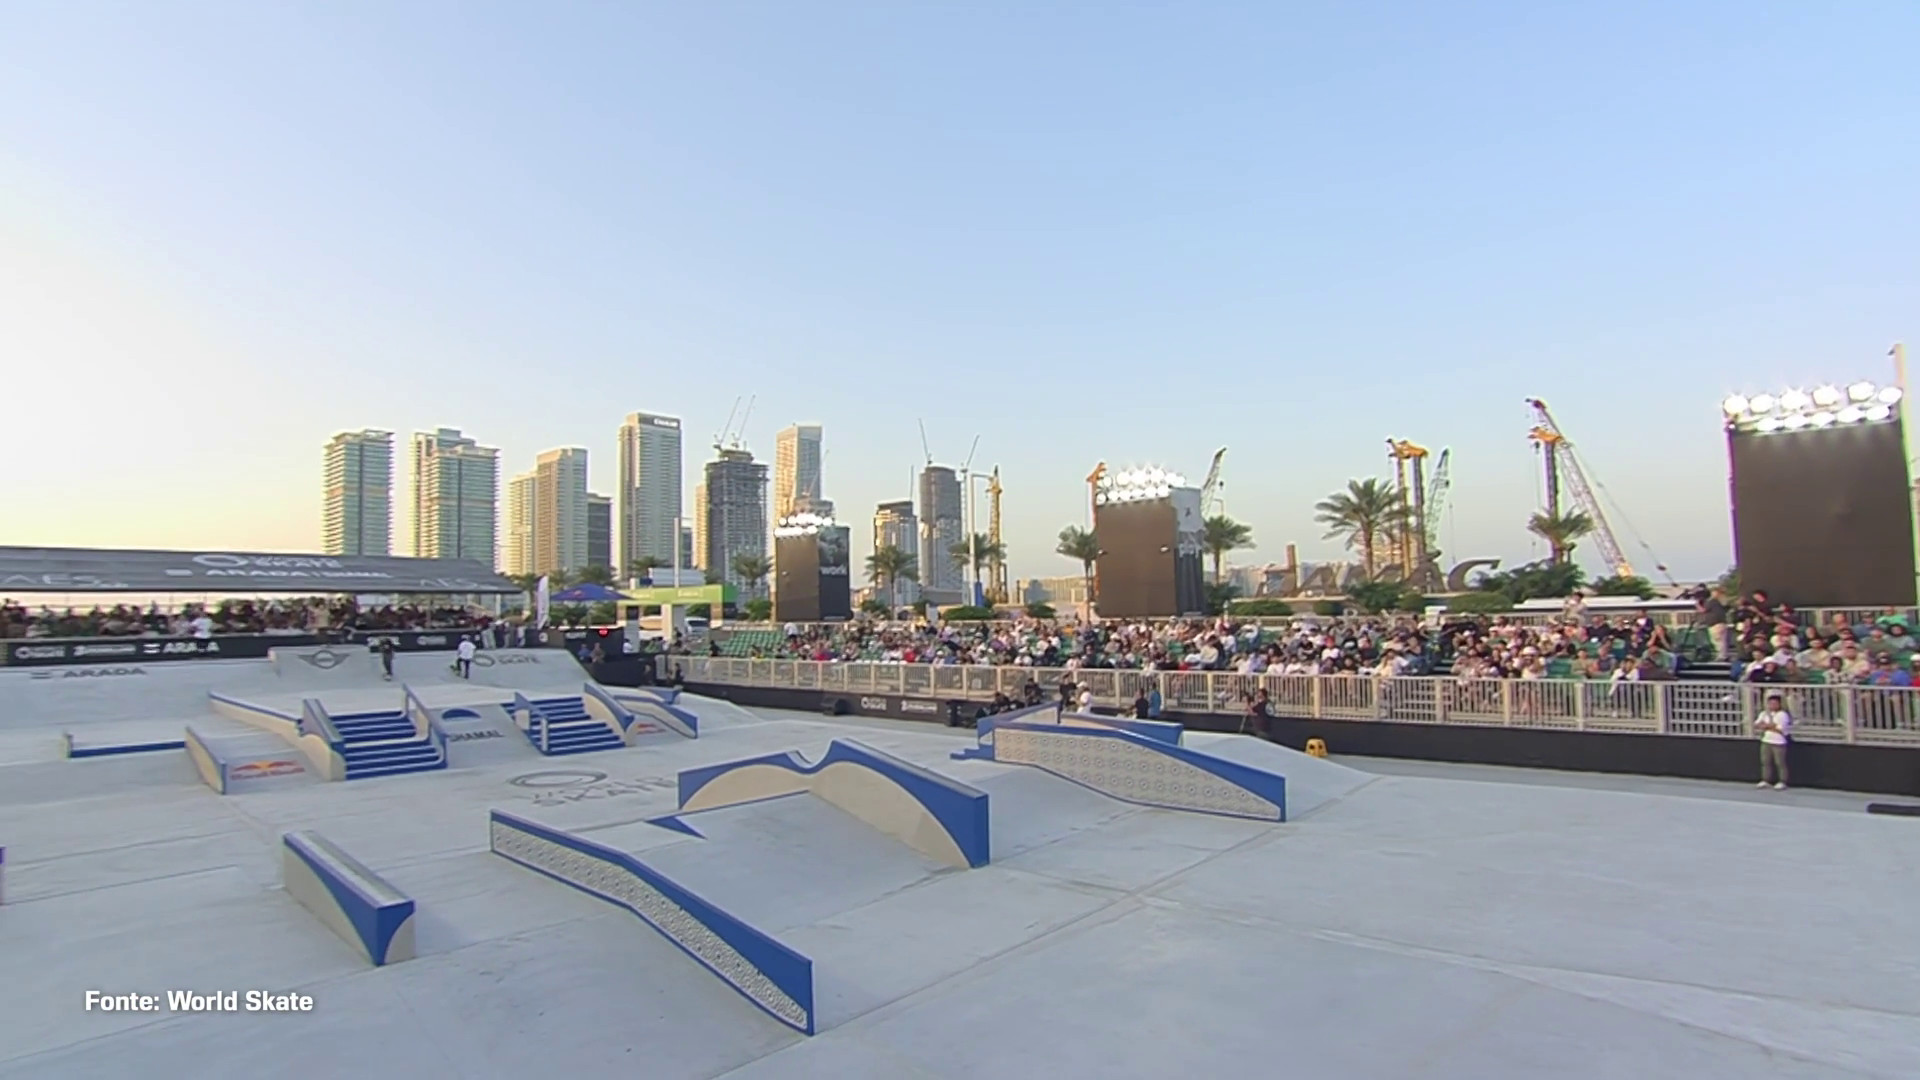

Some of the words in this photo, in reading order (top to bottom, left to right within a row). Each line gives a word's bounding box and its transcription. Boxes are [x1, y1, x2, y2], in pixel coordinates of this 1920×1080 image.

[821, 565, 848, 576] work
[162, 641, 220, 654] ARAA
[62, 667, 147, 679] ARADA
